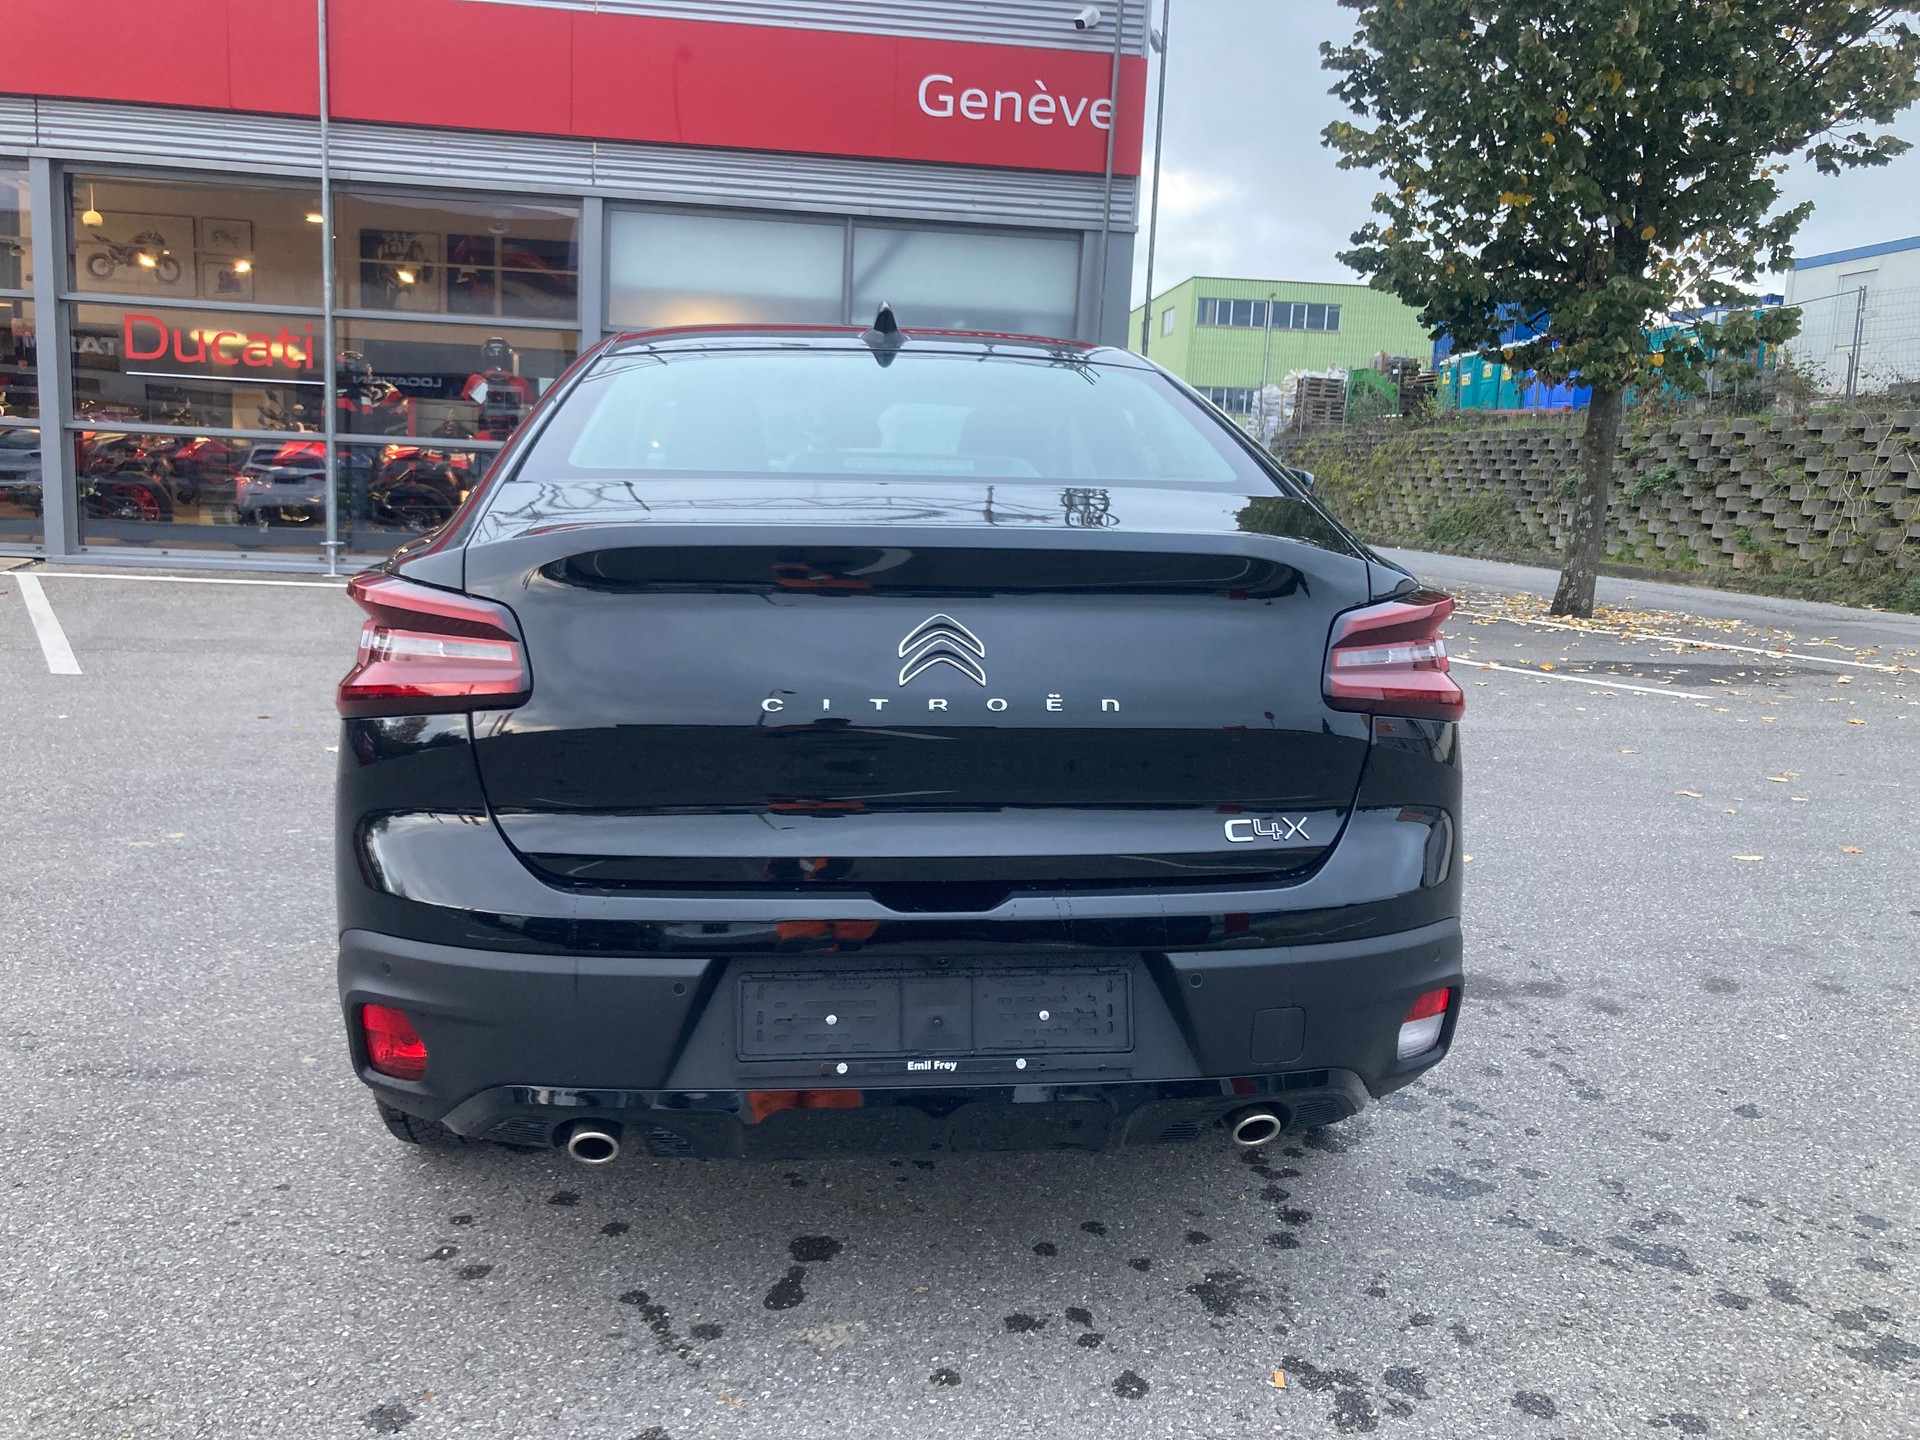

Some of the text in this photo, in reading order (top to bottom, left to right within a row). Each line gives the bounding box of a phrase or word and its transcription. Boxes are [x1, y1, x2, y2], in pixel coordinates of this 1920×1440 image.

[917, 74, 1117, 130] Genève
[124, 314, 314, 369] Ducati
[1224, 816, 1310, 842] C4X
[907, 1060, 958, 1072] Emil Frey
